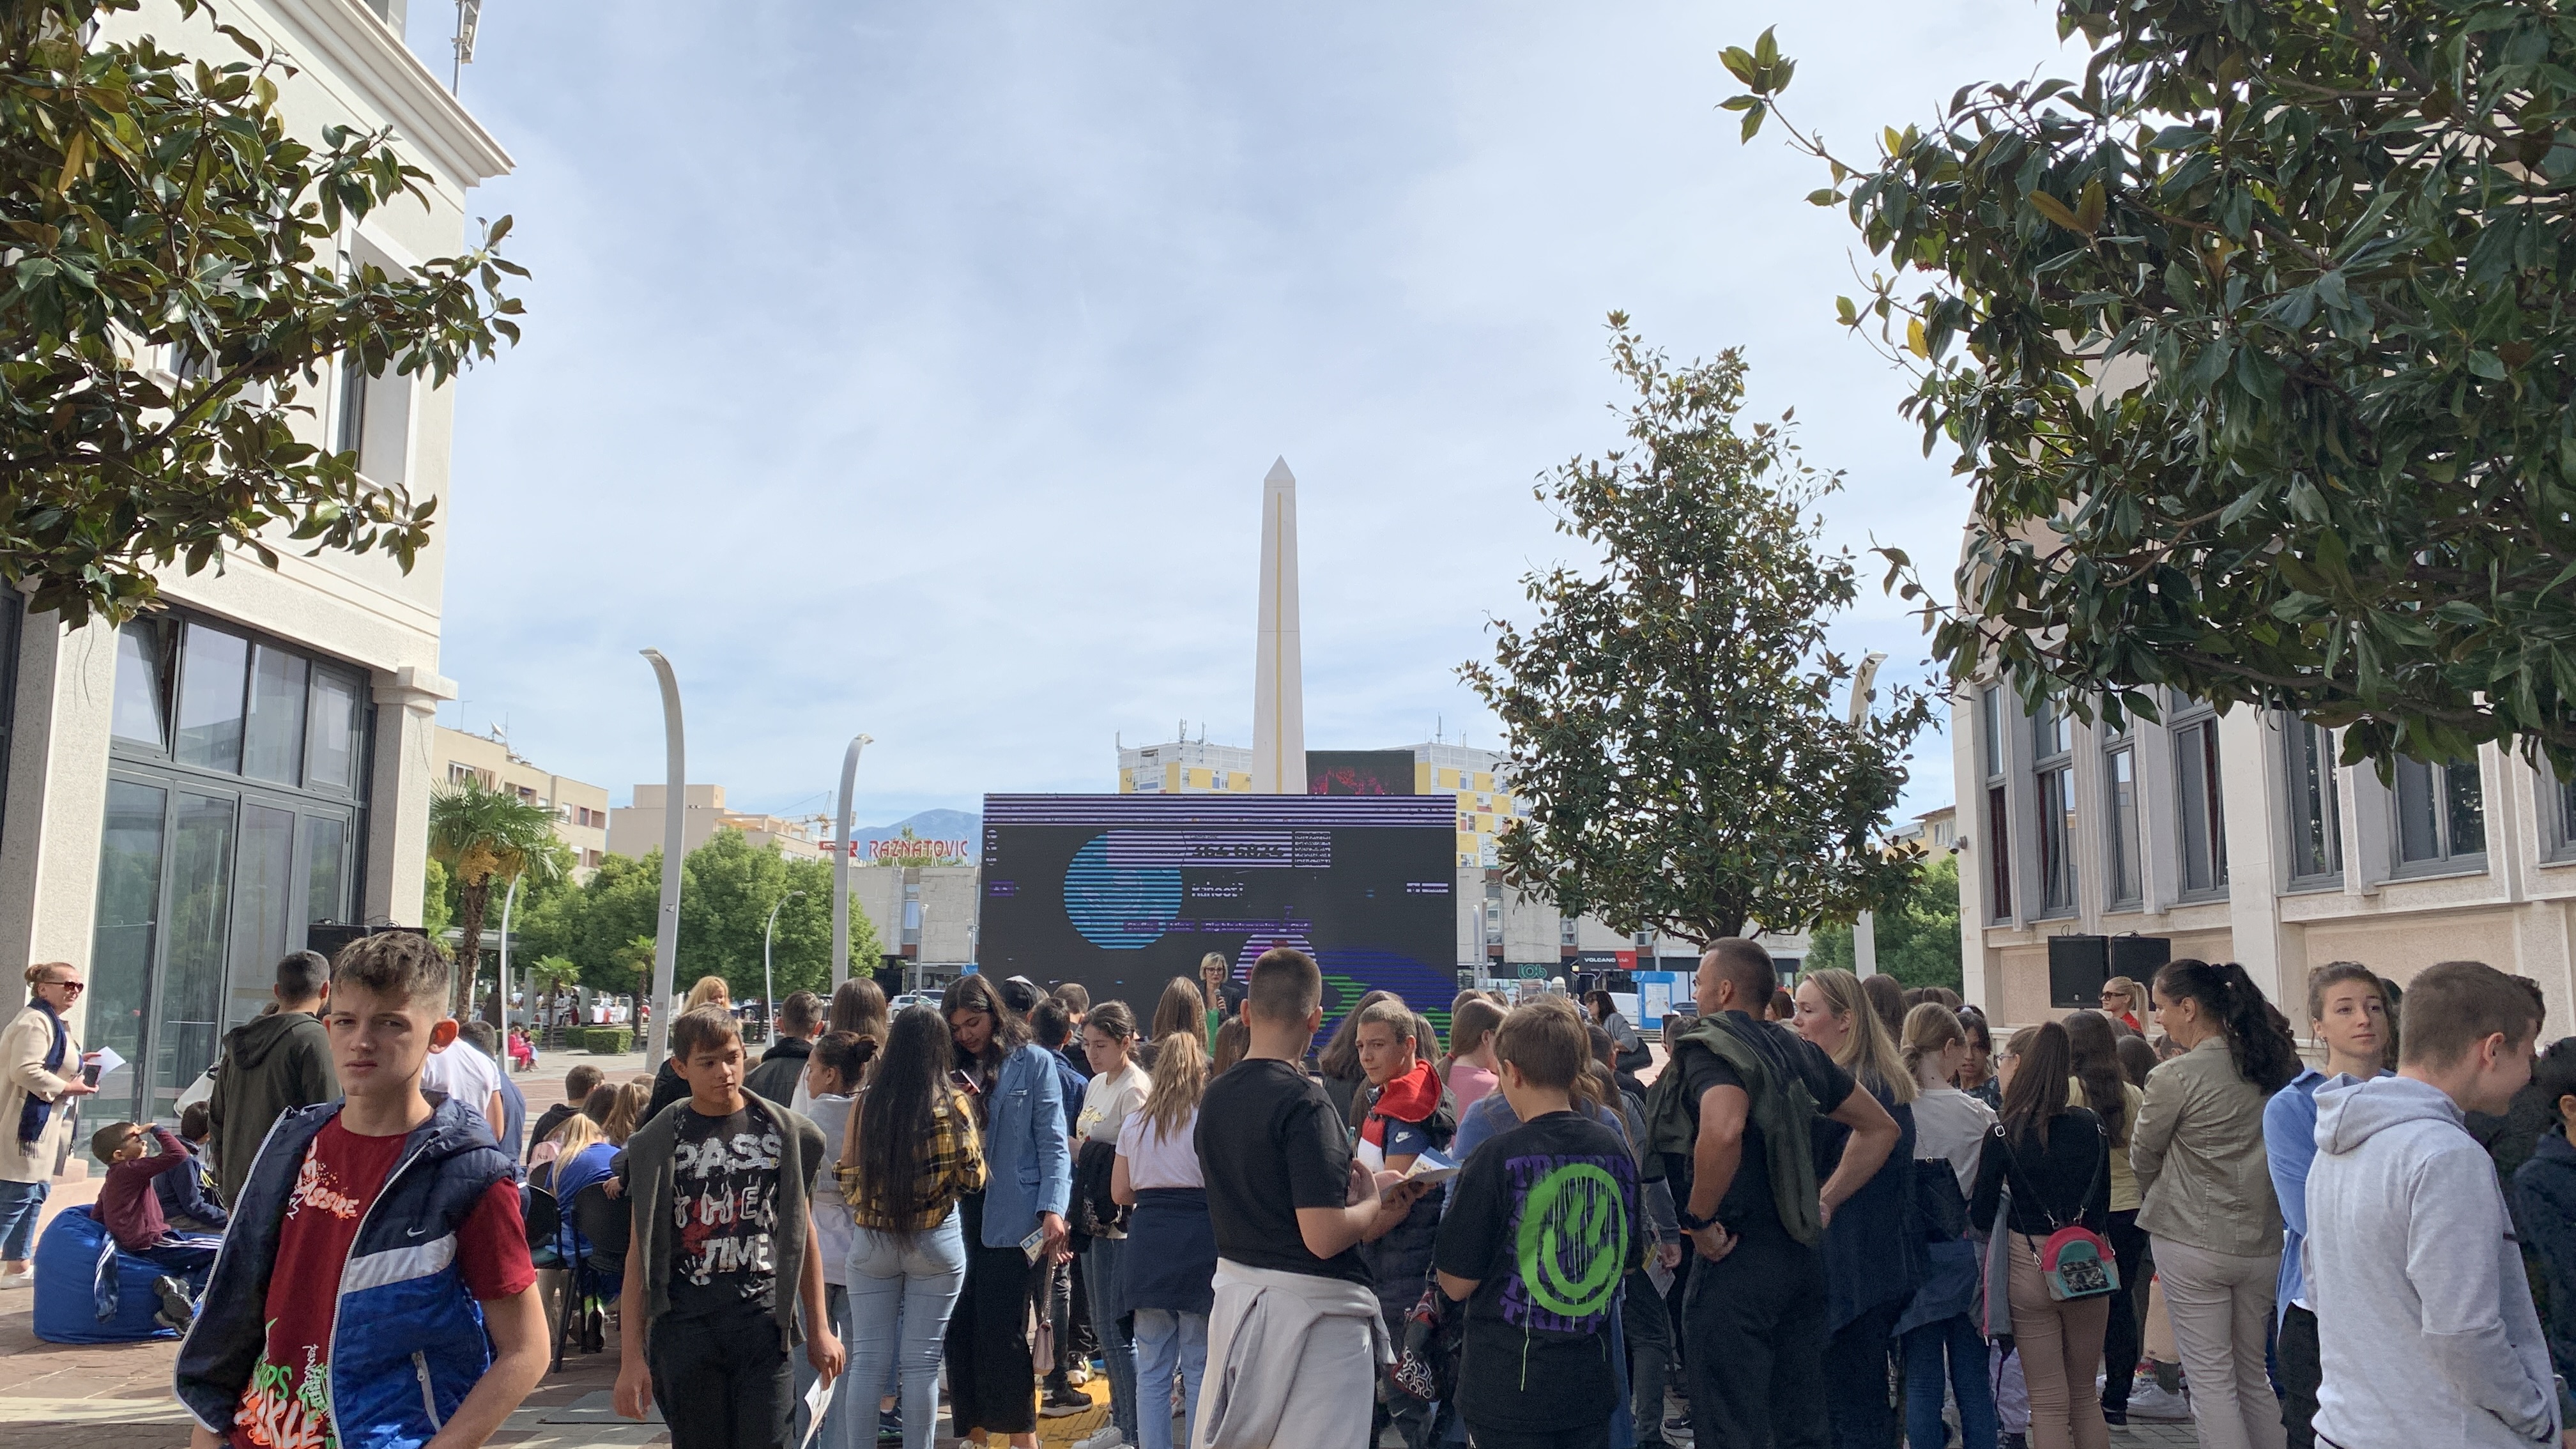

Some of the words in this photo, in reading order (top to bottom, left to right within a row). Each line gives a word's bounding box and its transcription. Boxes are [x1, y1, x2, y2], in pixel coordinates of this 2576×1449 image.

[675, 1133, 782, 1179] PASS
[746, 1158, 769, 1166] DIGITAL
[674, 1181, 759, 1228] THE
[701, 1234, 774, 1275] TIME
